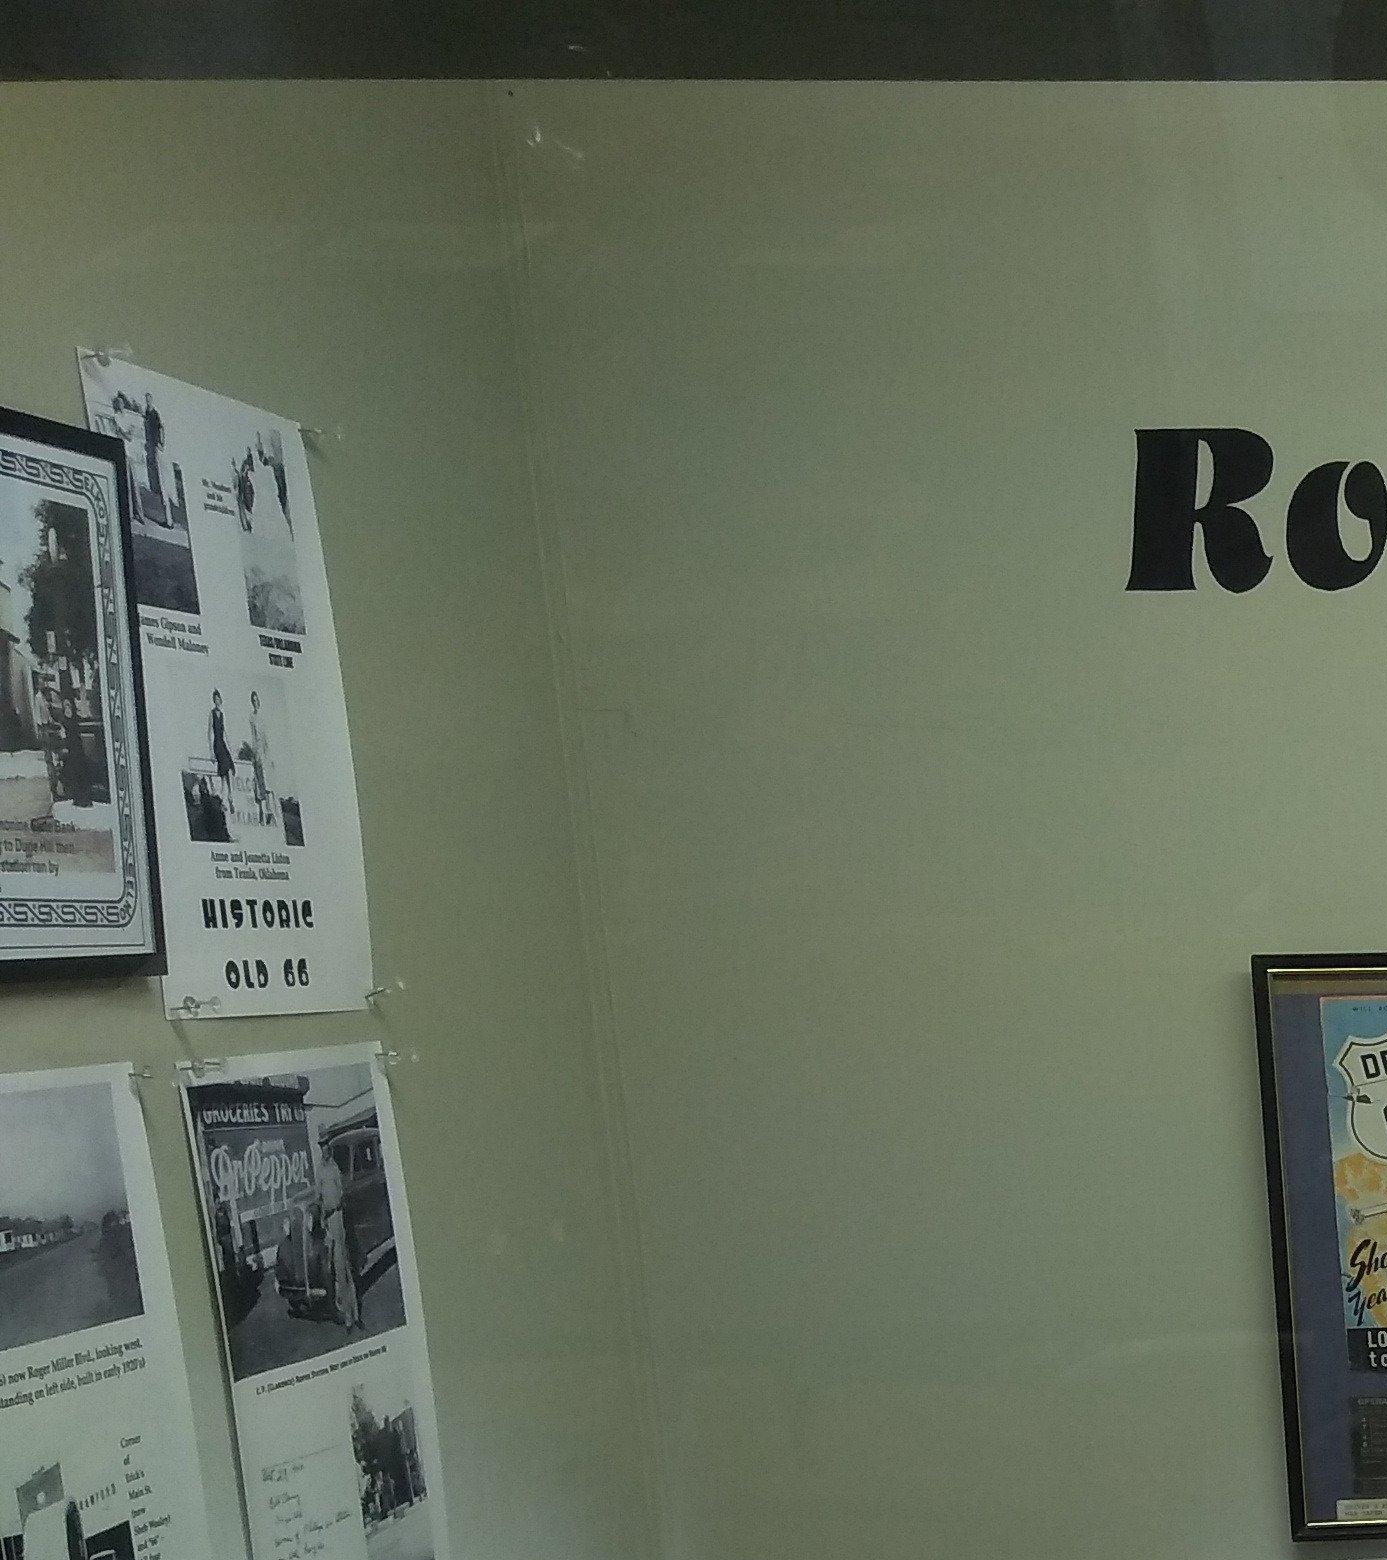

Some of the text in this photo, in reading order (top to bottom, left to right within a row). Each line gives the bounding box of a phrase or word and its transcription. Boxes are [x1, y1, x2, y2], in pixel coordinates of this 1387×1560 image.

[201, 899, 314, 929] HISTORIC
[225, 958, 310, 989] OLD 66
